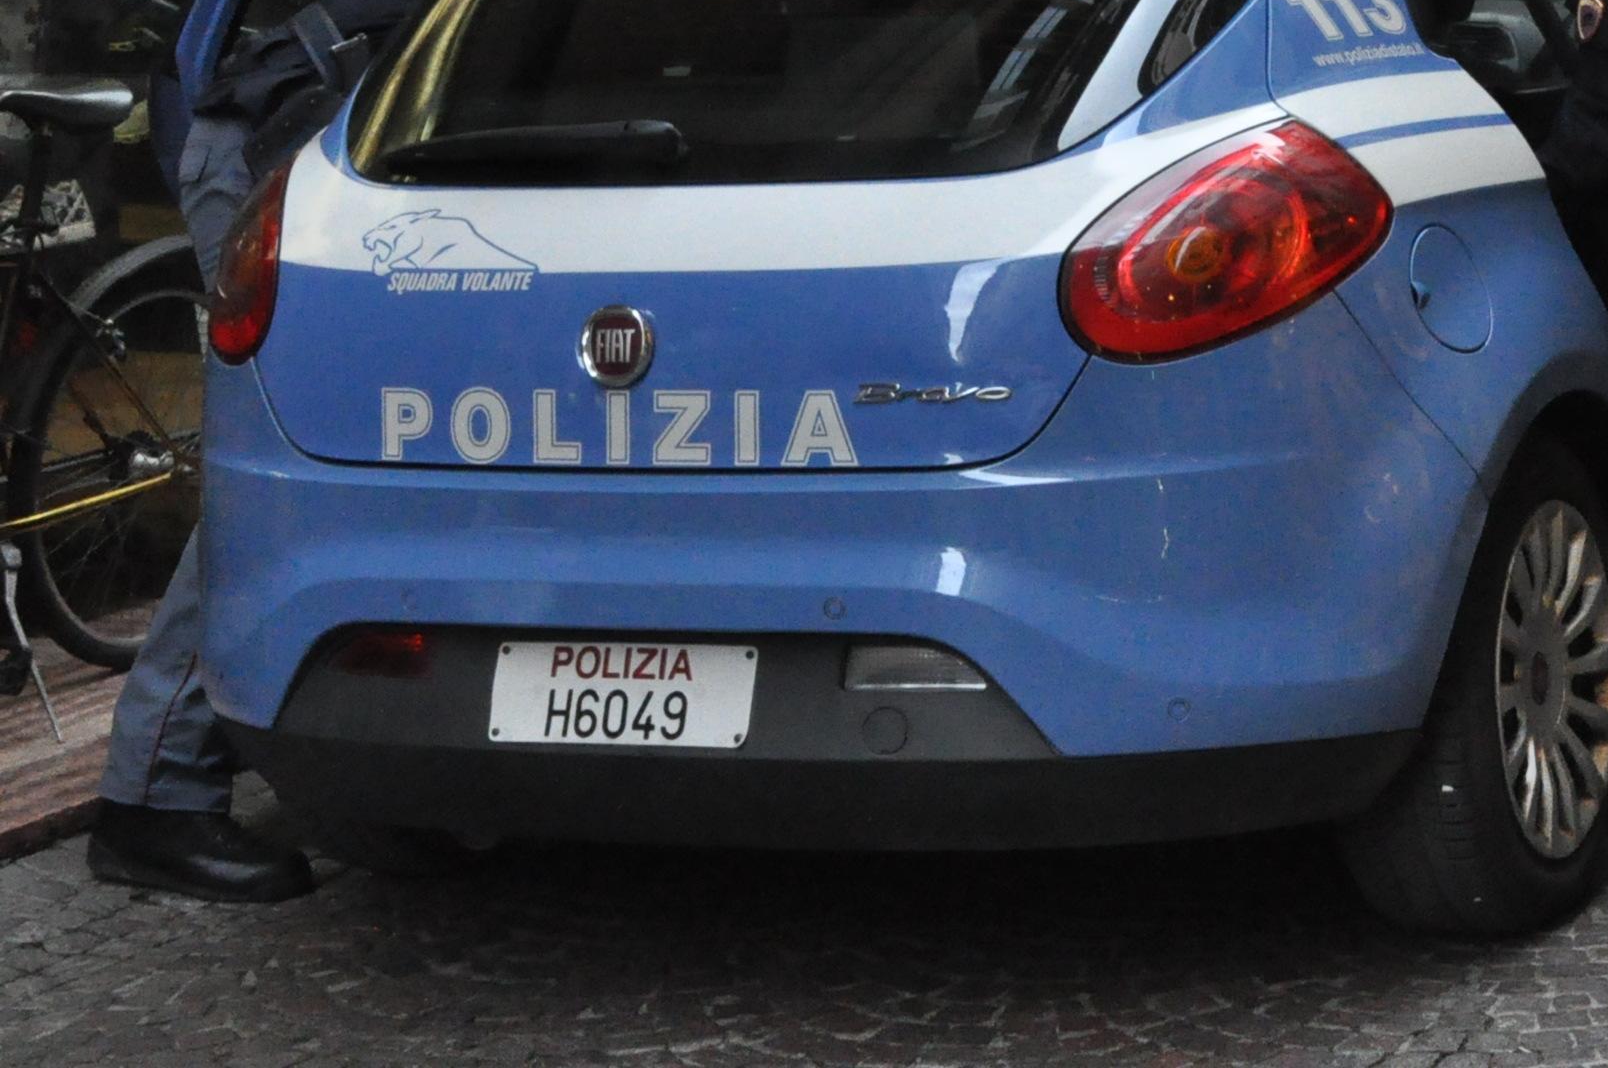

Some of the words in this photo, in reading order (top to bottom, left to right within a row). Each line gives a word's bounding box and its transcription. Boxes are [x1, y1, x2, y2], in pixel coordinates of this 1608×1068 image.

[388, 272, 456, 295] SQUADRA
[461, 271, 534, 291] VOLANTE
[596, 328, 635, 364] FIAT
[381, 386, 859, 466] POLIZIA
[551, 646, 693, 681] POLIZIA
[544, 688, 688, 741] H6049
